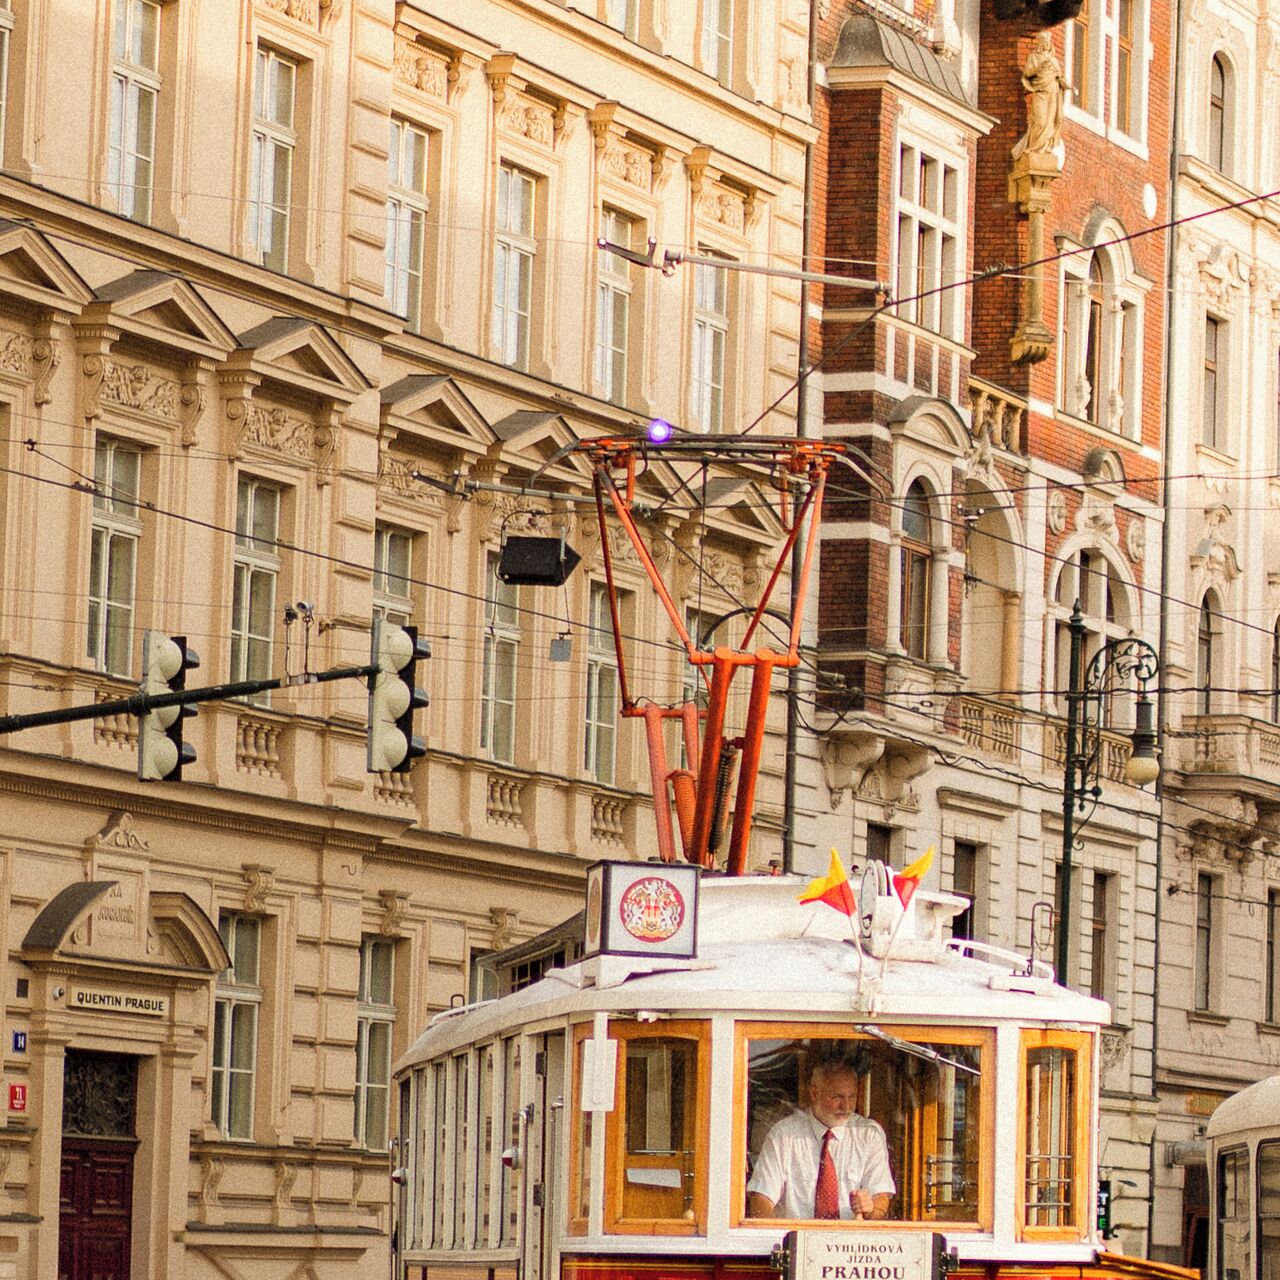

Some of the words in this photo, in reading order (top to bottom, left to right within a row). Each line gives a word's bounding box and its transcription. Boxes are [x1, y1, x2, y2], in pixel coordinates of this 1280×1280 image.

[77, 991, 122, 1007] QUENTIN
[125, 996, 165, 1012] PRAGUE
[826, 1242, 904, 1254] VYHLÍDKOVÁ
[821, 1266, 905, 1280] PRAHOU
